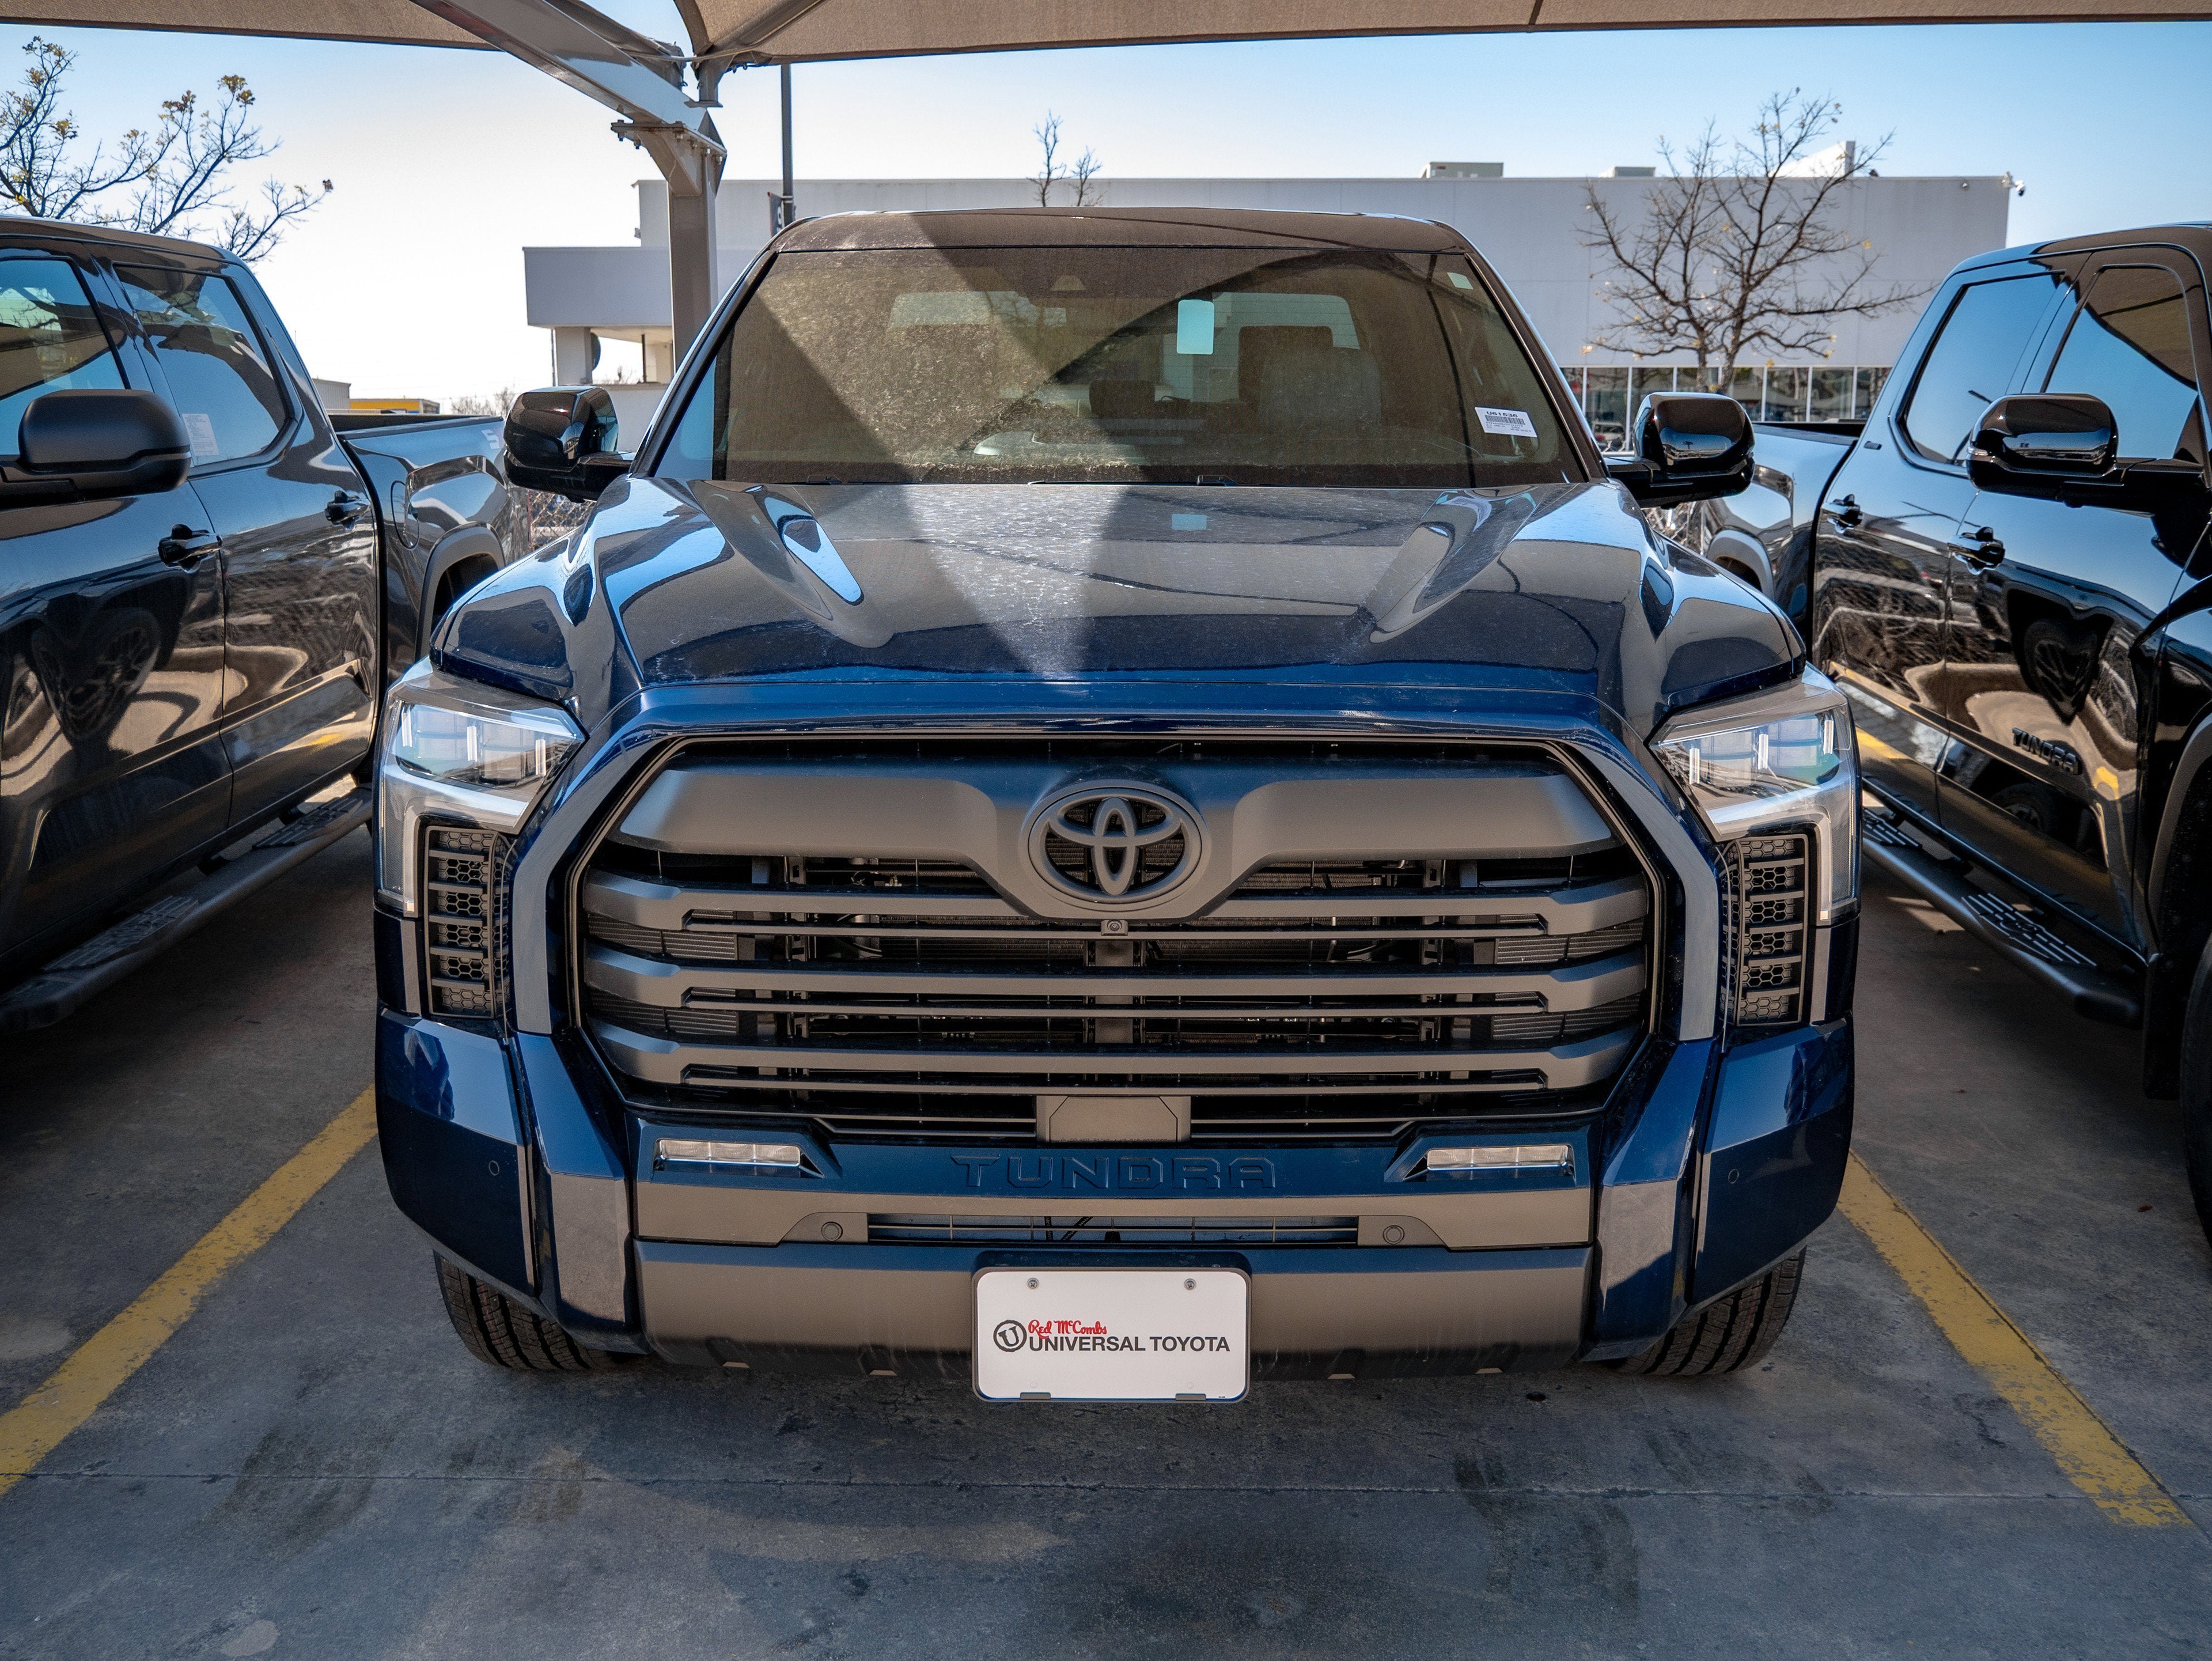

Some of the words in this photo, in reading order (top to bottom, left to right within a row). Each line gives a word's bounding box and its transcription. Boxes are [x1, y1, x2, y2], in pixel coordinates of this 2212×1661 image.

[2012, 727, 2081, 774] TUNDRA
[950, 1156, 1276, 1189] TUNDRA
[1028, 1319, 1052, 1339] Red
[1054, 1320, 1108, 1335] McCombs
[1029, 1335, 1146, 1352] UNIVERSAL
[1149, 1335, 1230, 1352] TOYOTA
